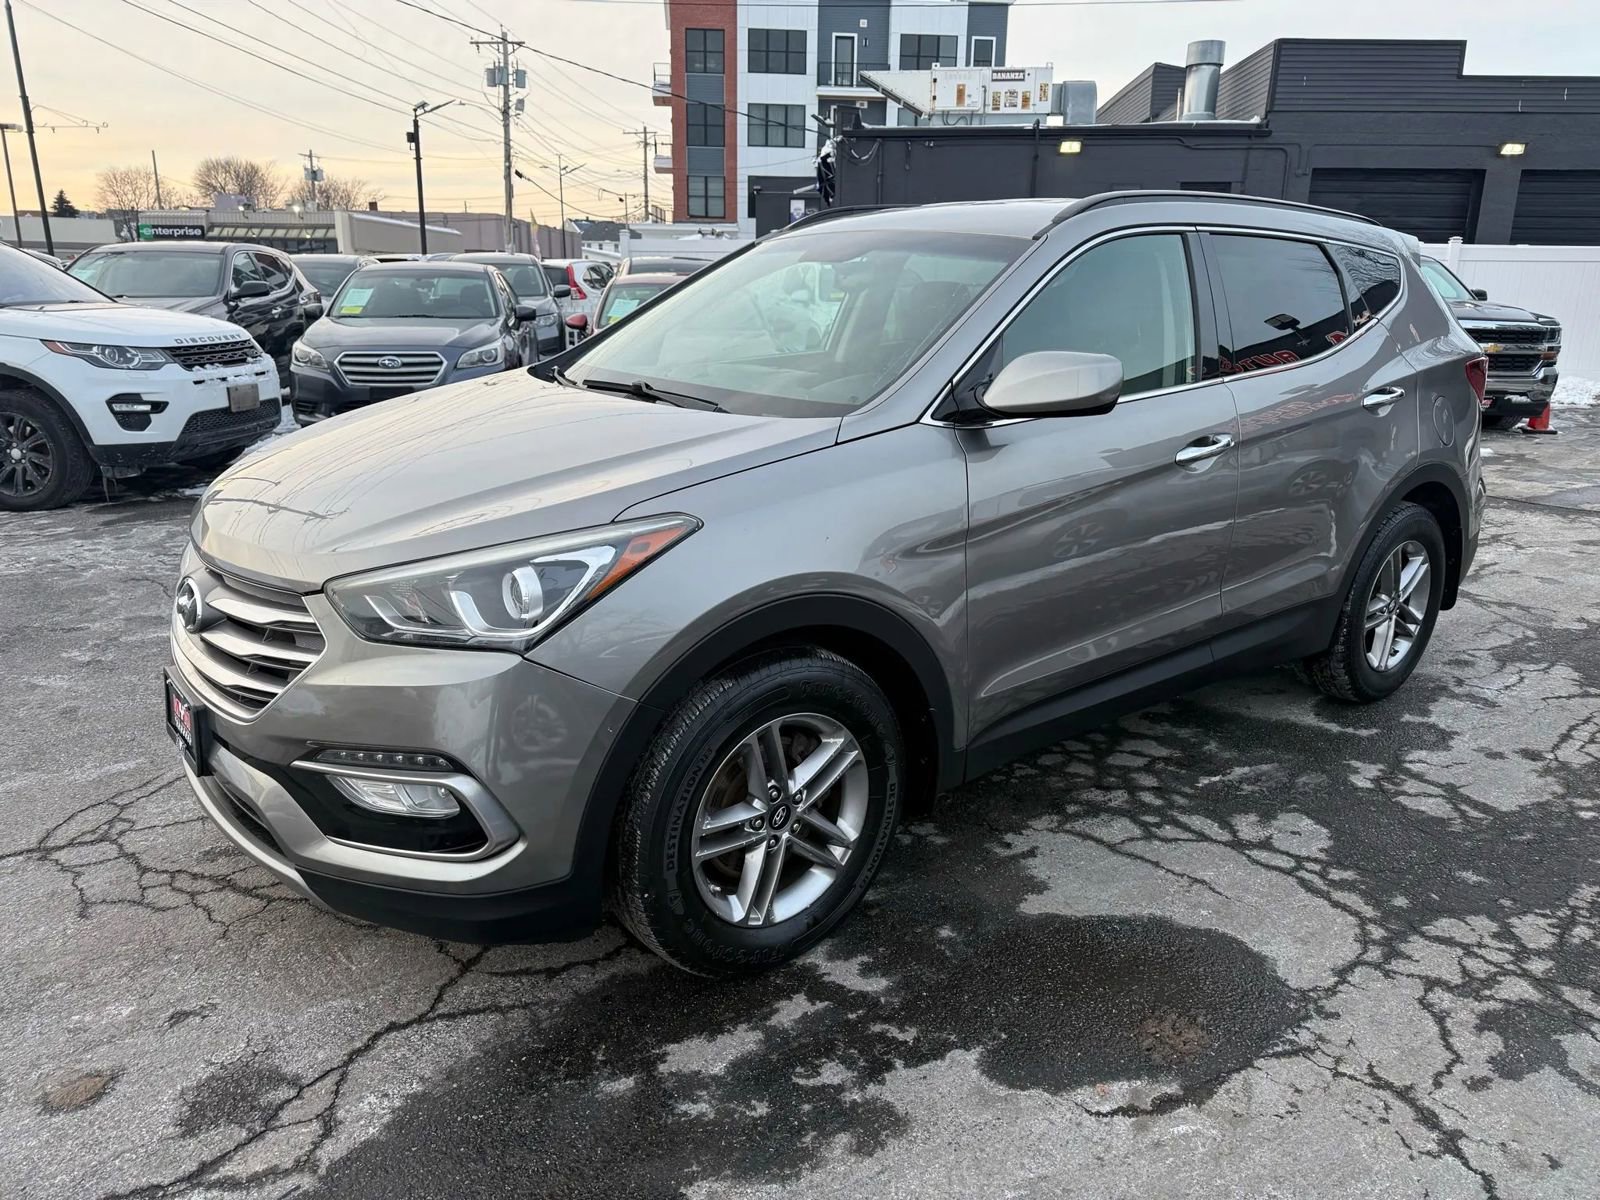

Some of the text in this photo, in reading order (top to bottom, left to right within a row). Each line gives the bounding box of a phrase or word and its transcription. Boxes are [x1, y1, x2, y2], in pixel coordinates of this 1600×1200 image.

[140, 226, 202, 238] enterprise
[174, 333, 241, 345] DISCOVERY
[666, 765, 703, 872] DESTINATION
[867, 782, 897, 873] DESTINATION
